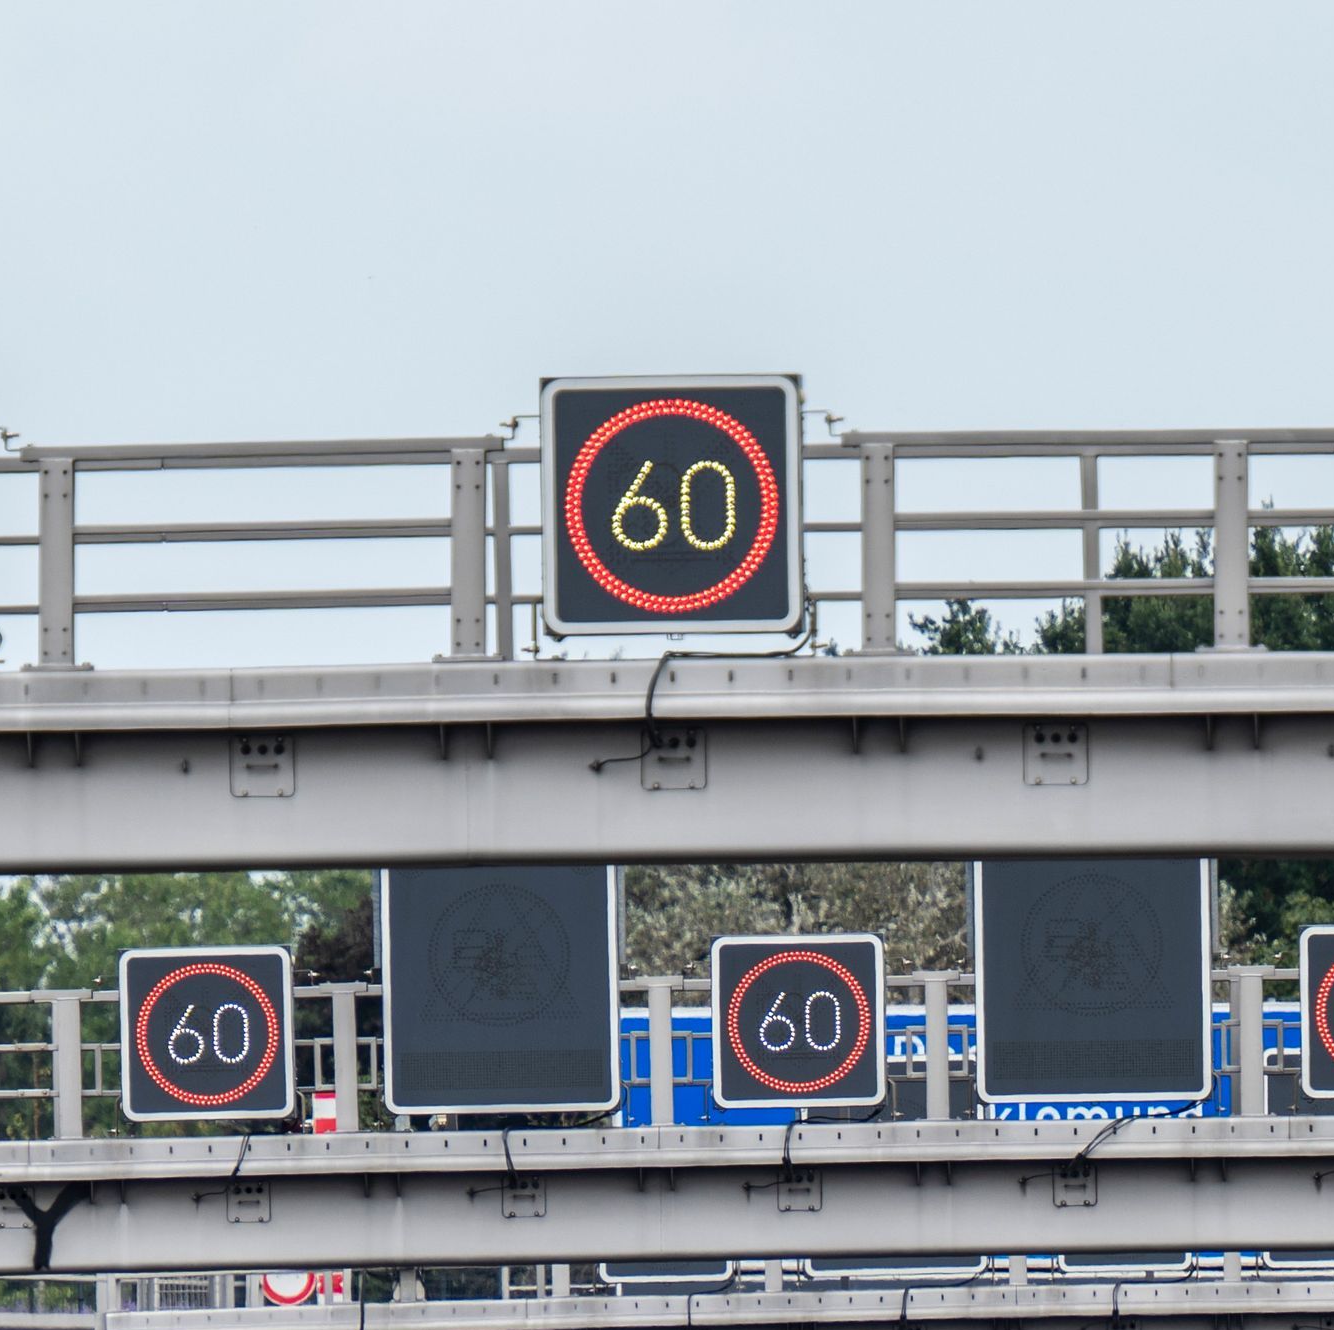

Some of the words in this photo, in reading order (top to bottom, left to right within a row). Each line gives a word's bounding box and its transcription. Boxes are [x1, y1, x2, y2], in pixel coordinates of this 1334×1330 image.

[610, 458, 736, 550] 60
[168, 1004, 250, 1065] 60
[759, 991, 841, 1051] 60
